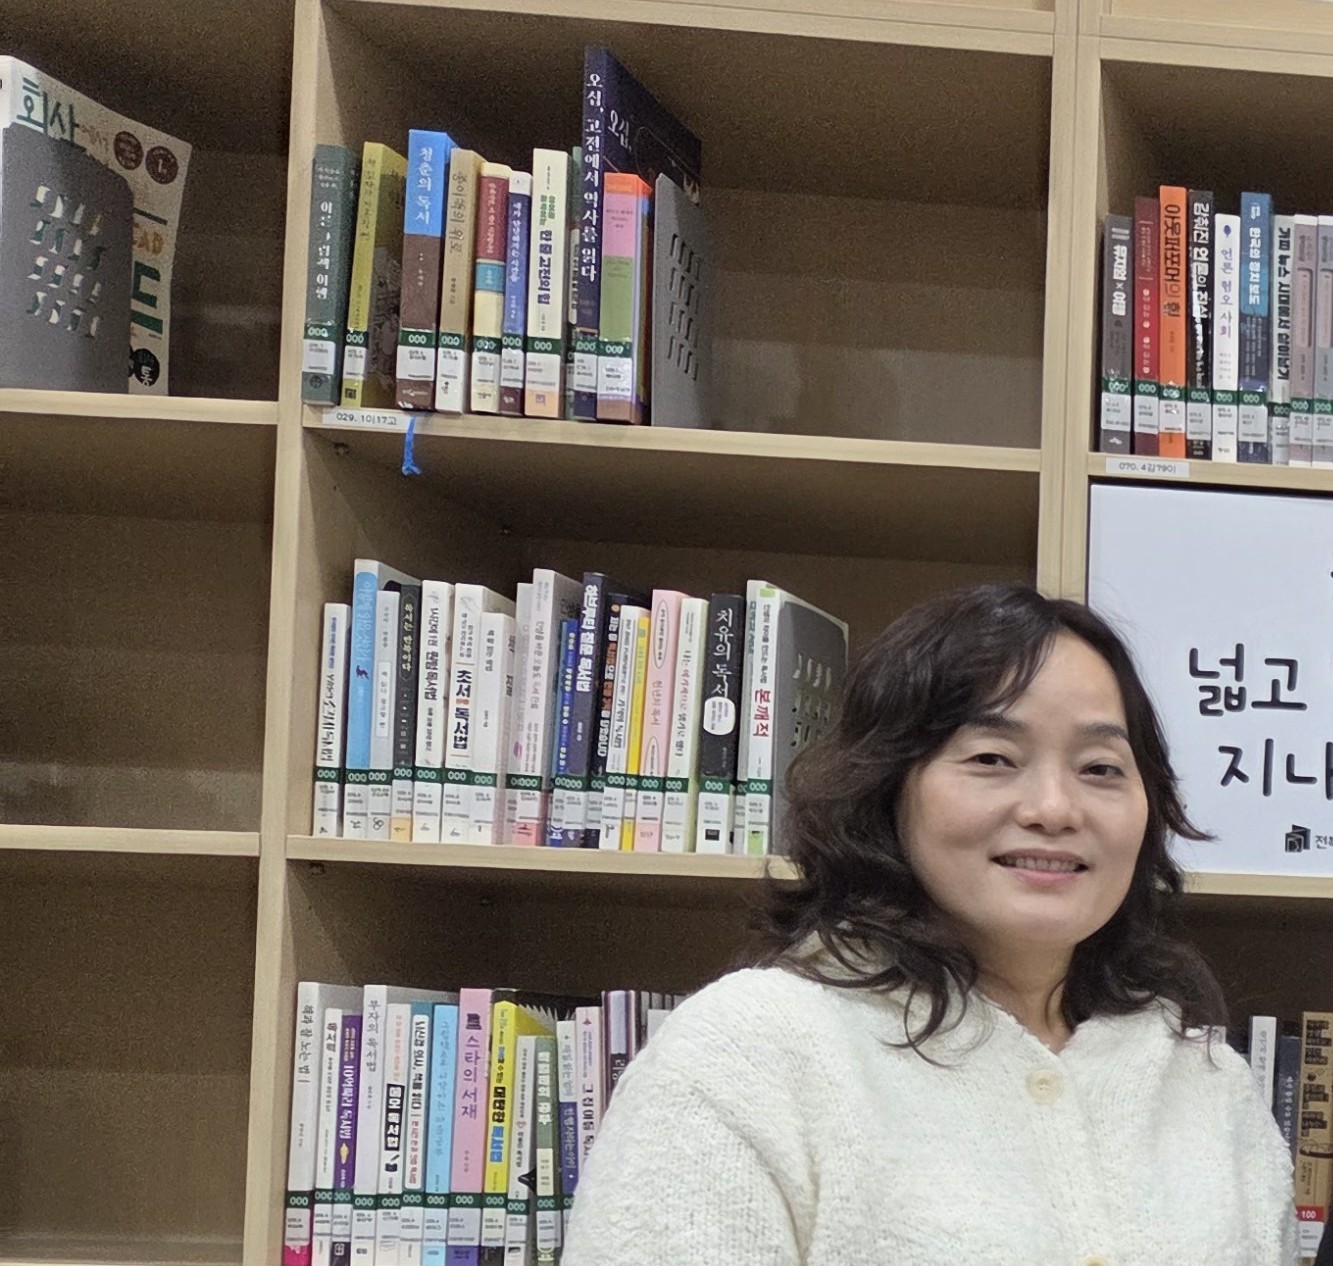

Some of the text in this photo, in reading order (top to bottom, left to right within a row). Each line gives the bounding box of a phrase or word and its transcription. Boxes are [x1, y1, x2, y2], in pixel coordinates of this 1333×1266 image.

[579, 245, 597, 282] 읽다
[408, 334, 426, 344] 000
[713, 608, 733, 661] 치유의
[577, 657, 594, 693] 독서법
[1189, 642, 1307, 716] 넓고
[752, 688, 772, 738] 본깨적
[705, 782, 722, 790] 000
[461, 1034, 481, 1119] 스타의 서재
[290, 1196, 308, 1205] 000
[508, 1202, 525, 1211] 000
